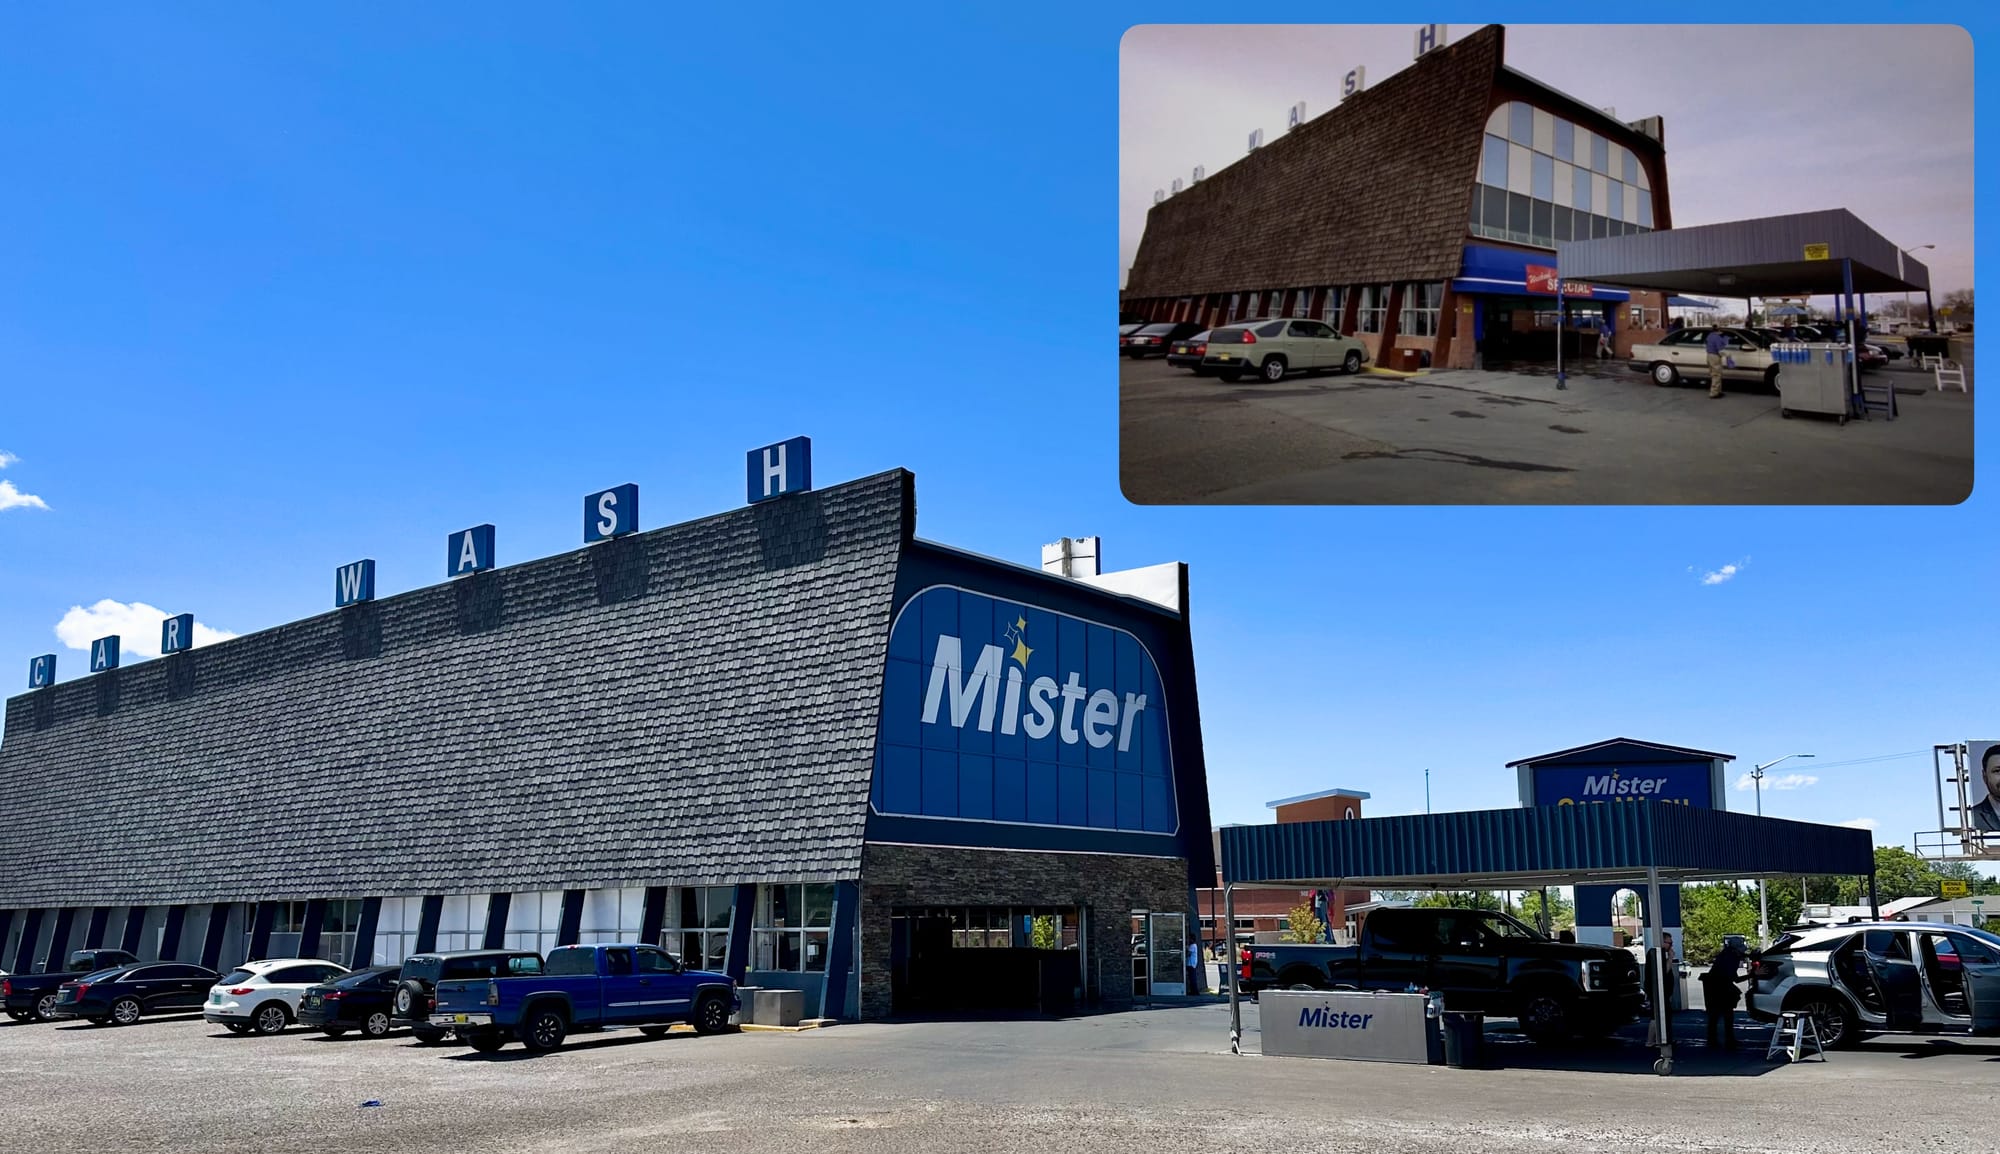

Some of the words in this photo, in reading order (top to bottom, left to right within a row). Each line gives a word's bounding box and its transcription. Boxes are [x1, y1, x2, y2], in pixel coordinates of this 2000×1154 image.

[921, 632, 1148, 753] Mister
[1583, 773, 1668, 796] Mister
[1298, 1005, 1374, 1030] Mister
